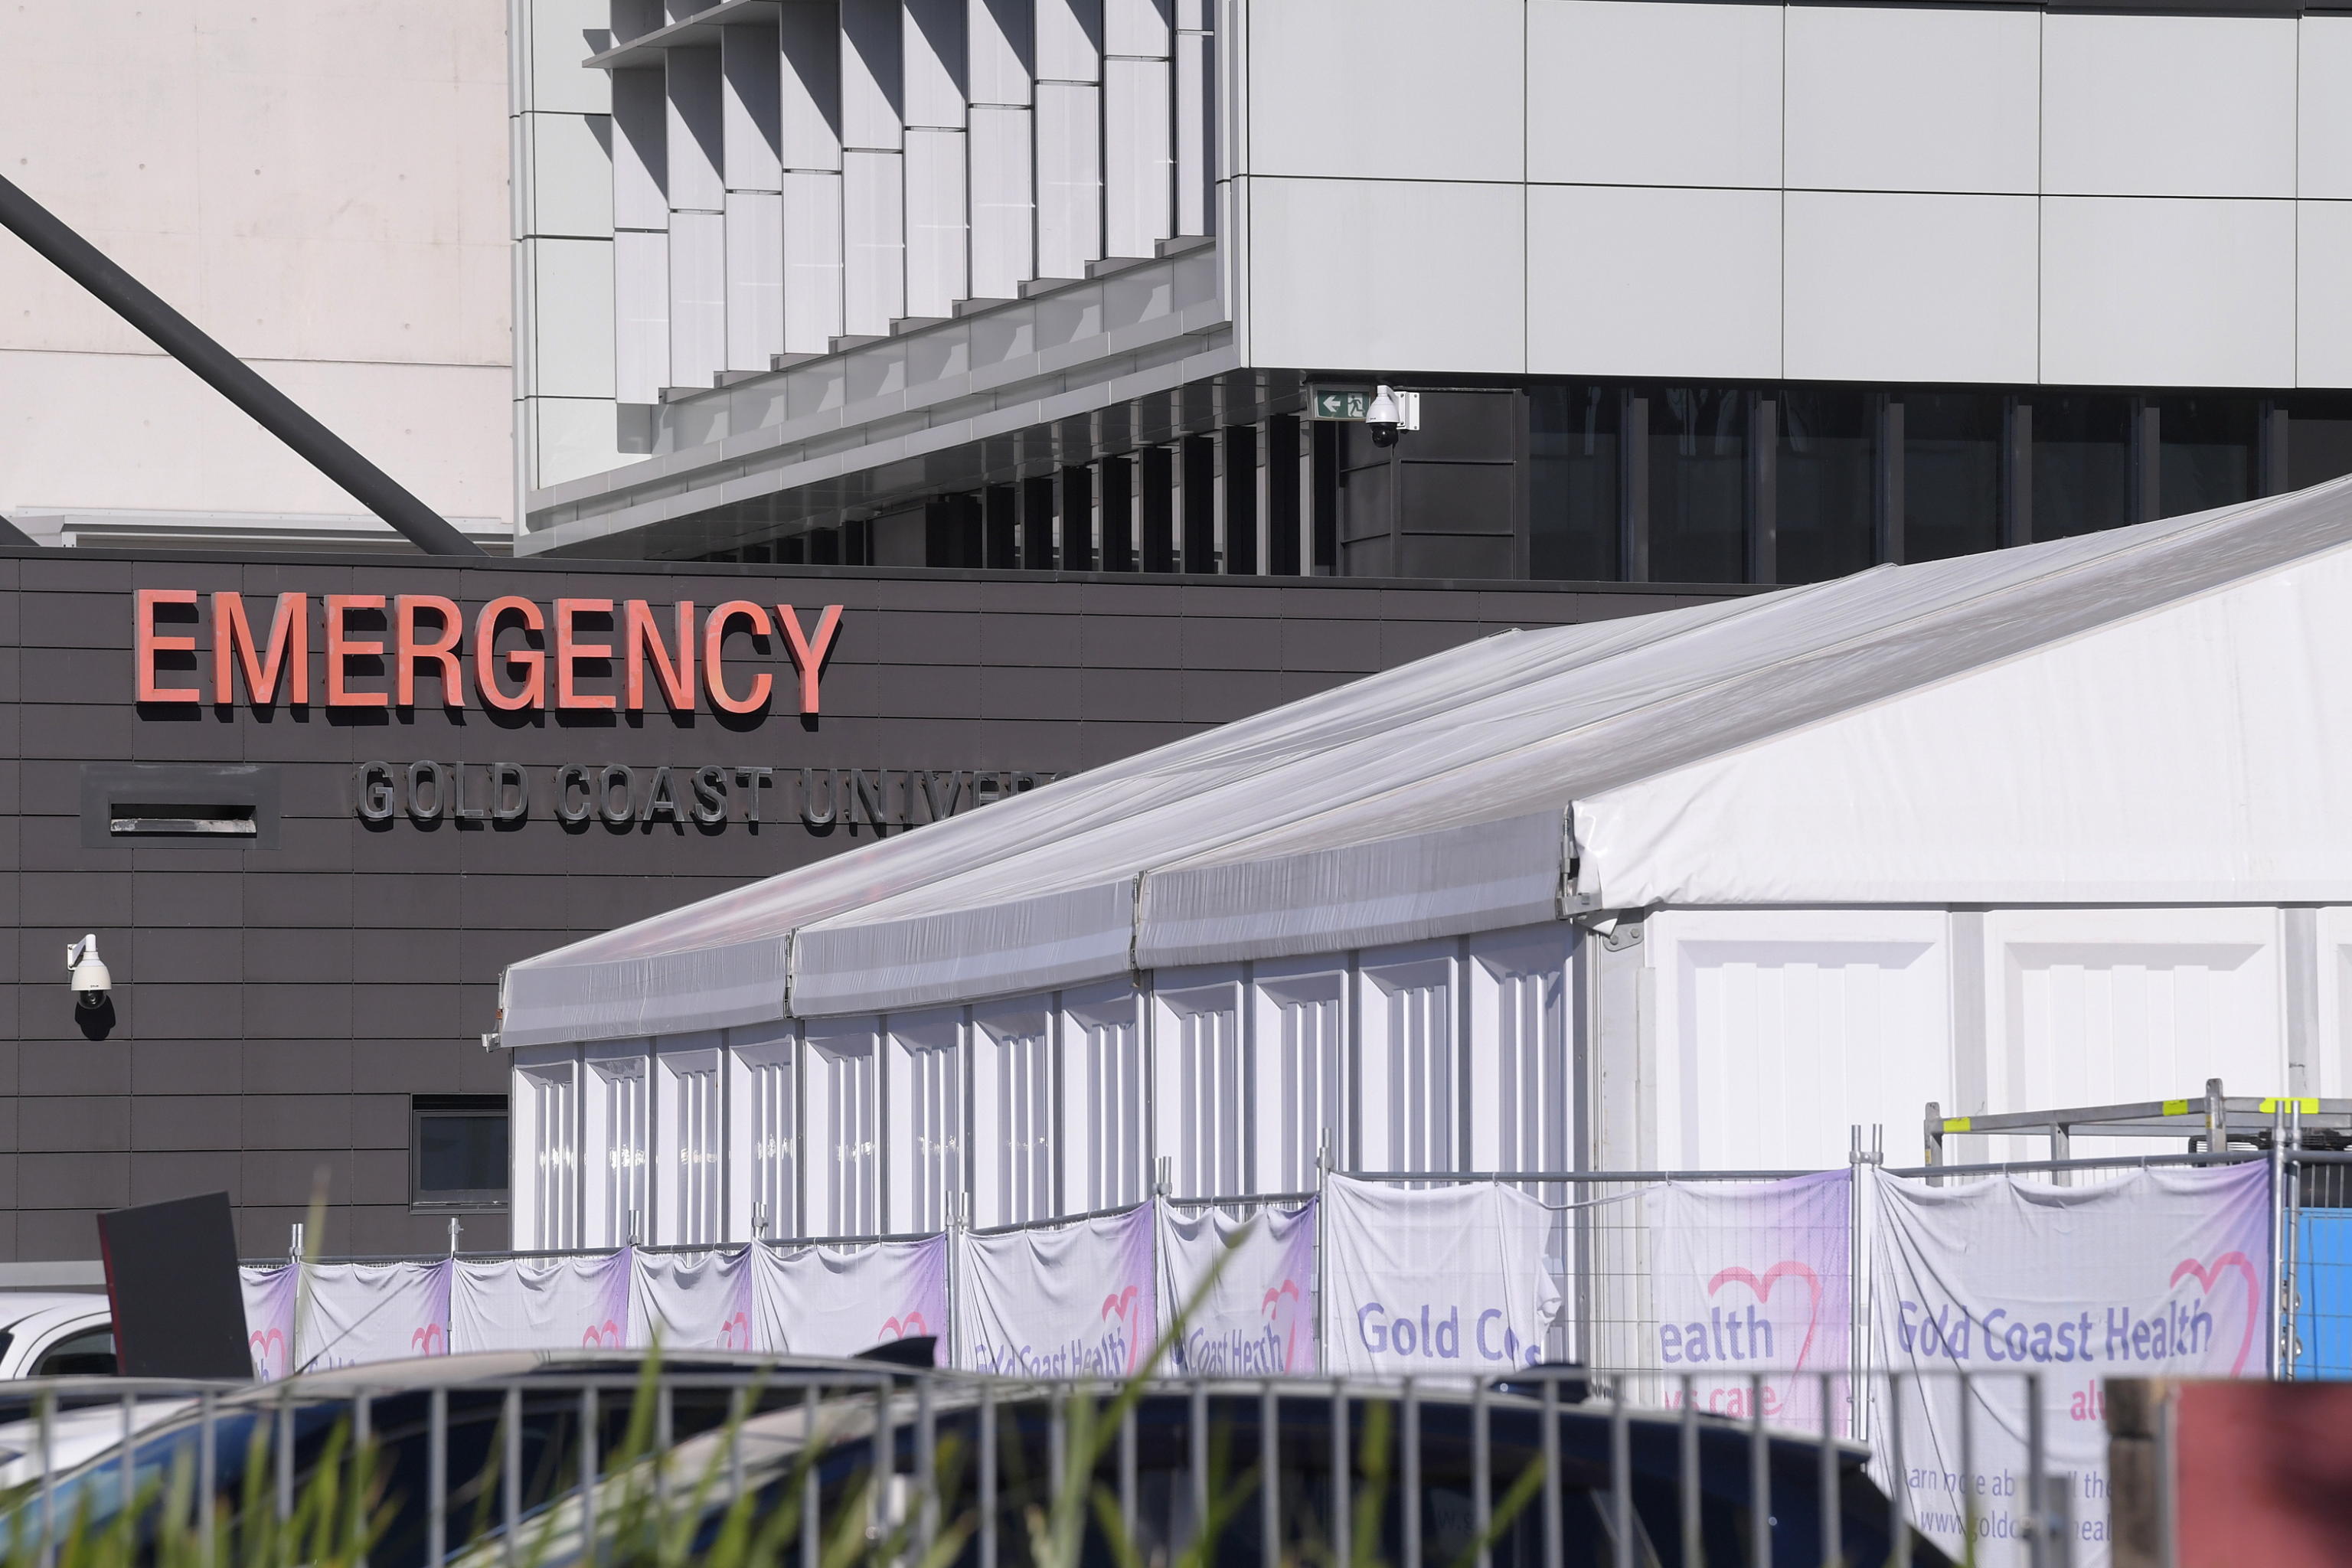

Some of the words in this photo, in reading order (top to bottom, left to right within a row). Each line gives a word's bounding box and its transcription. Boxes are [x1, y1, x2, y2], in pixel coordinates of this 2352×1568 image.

[133, 588, 844, 714] EMERGENCY
[358, 760, 528, 818] GOLD
[556, 763, 773, 822] COAST
[1358, 1302, 1459, 1359] Gold
[1897, 1302, 1970, 1360] Gold
[1984, 1308, 2094, 1363] Coast
[2105, 1298, 2213, 1361] Health
